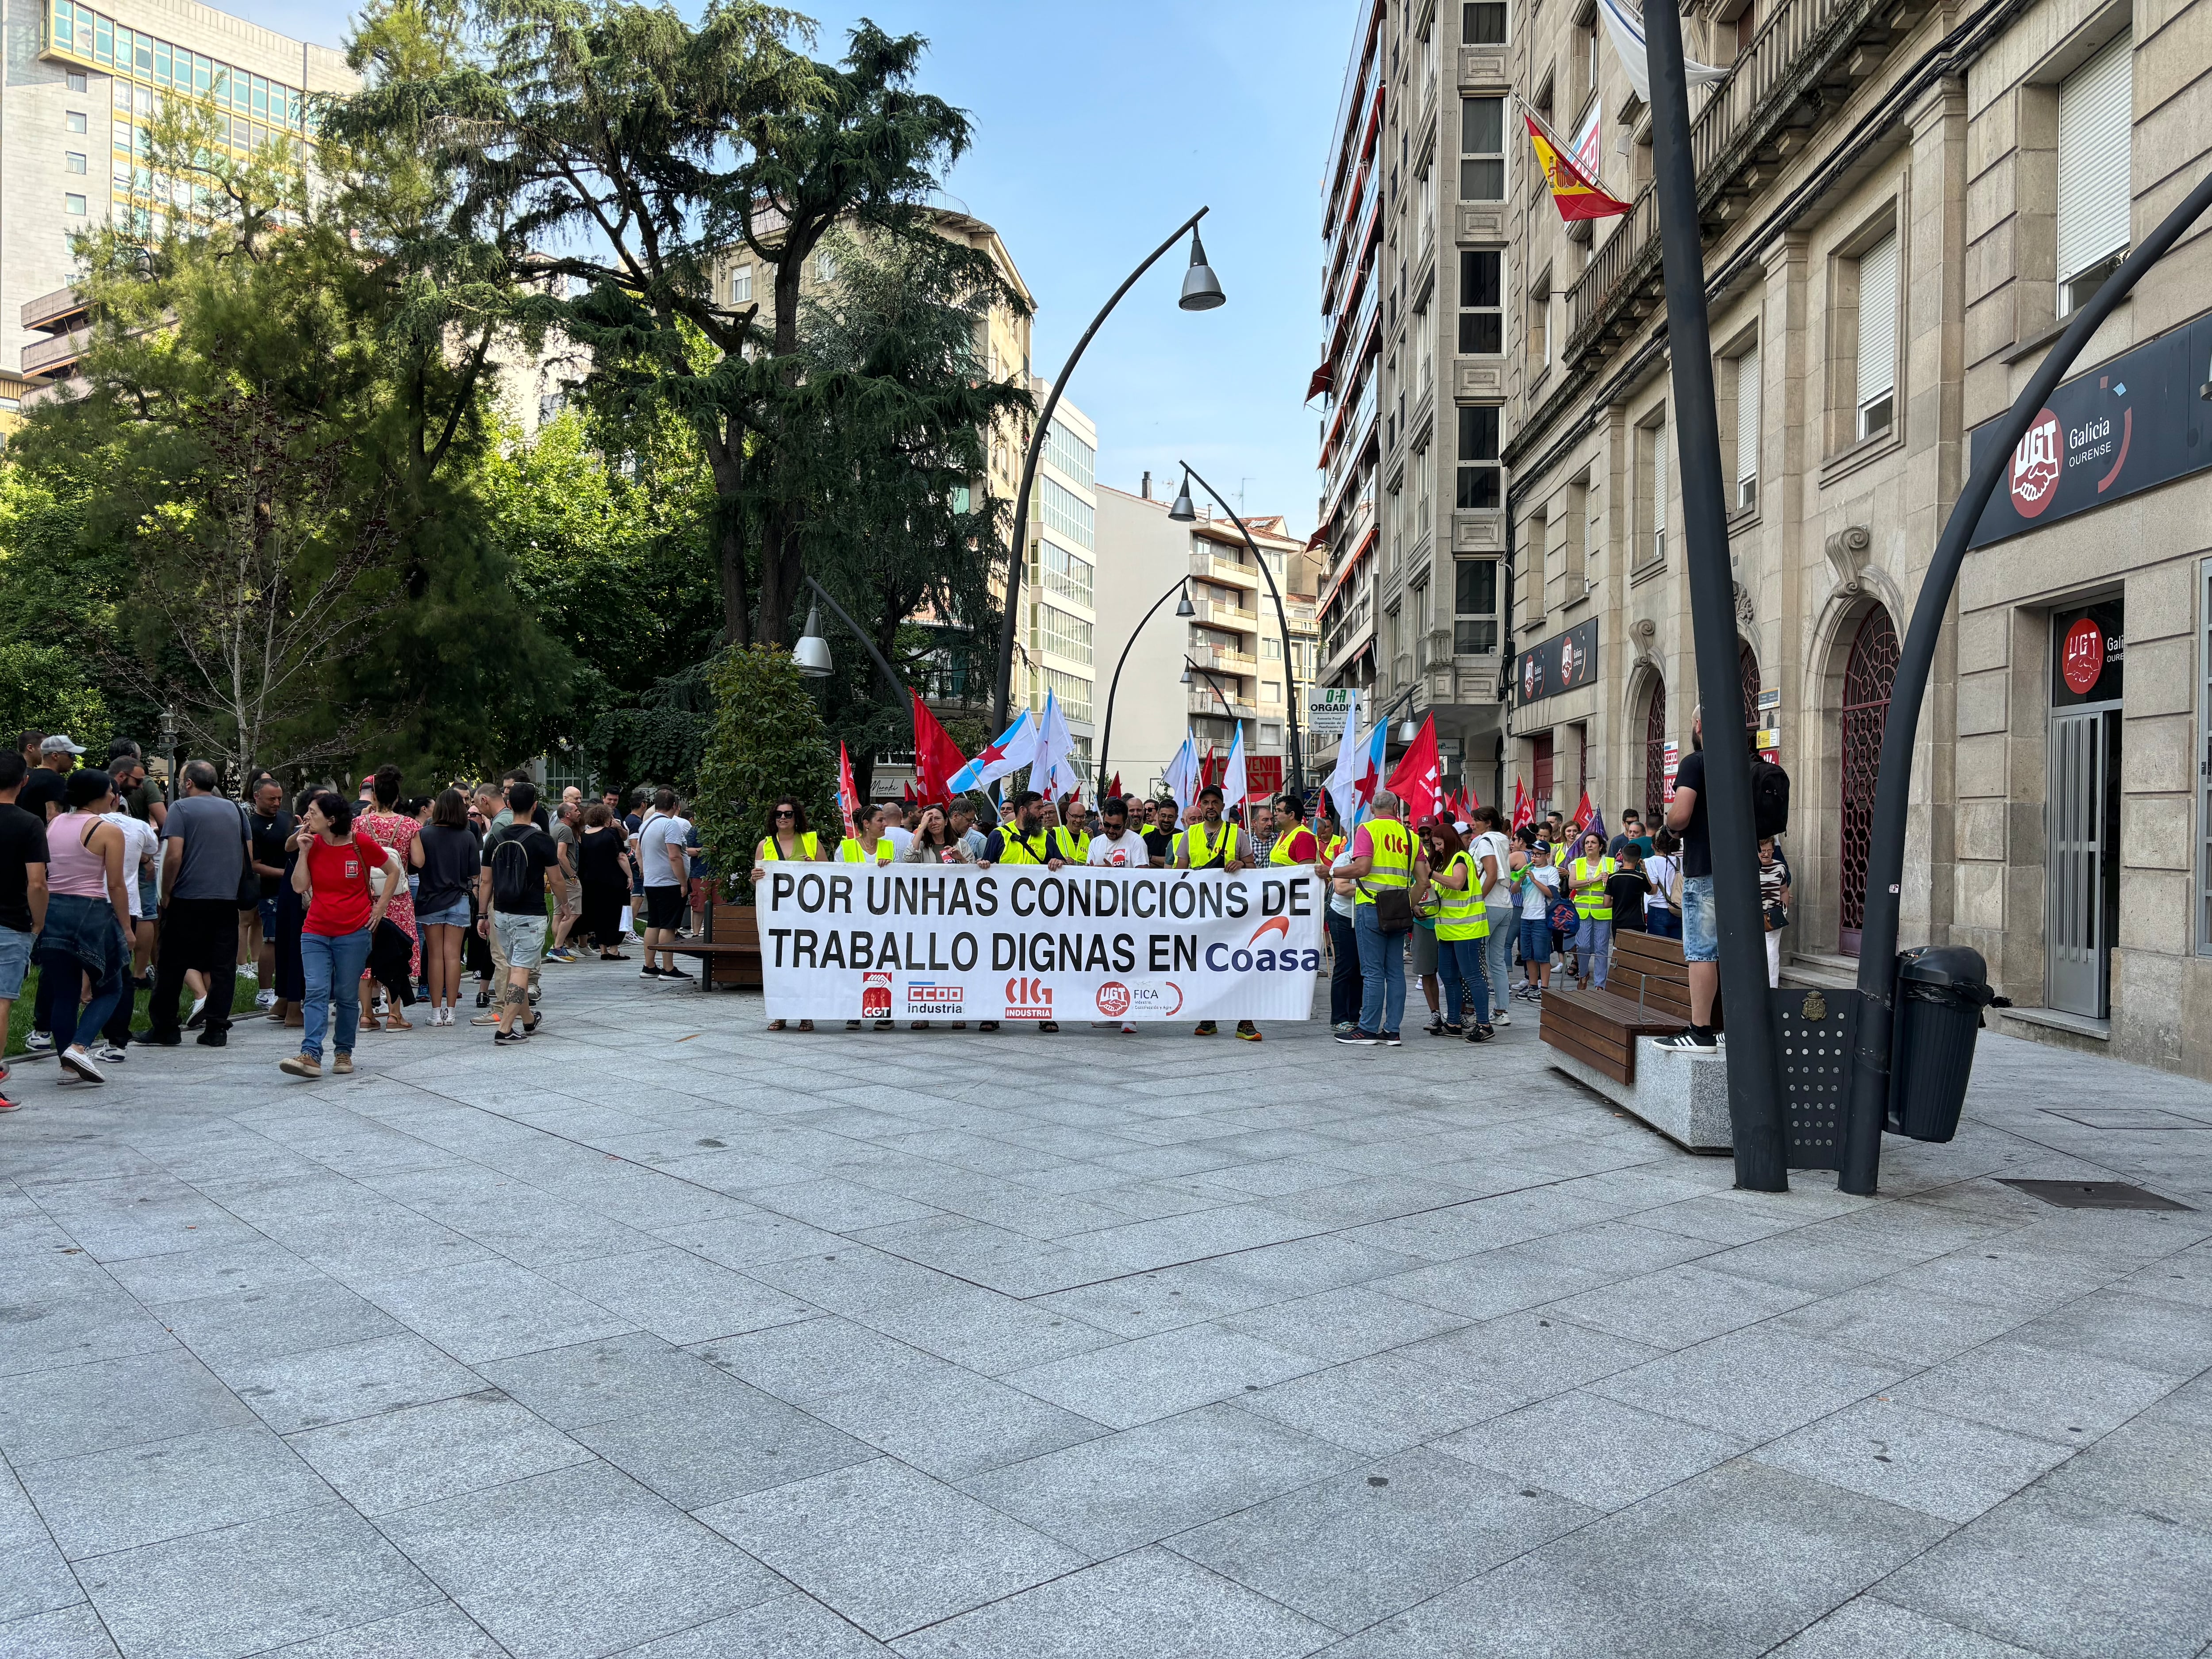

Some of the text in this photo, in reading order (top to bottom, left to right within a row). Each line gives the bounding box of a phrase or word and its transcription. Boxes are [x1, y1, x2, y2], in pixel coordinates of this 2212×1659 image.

[2069, 417, 2110, 449] Galicia
[2014, 419, 2056, 477] UGT
[2069, 441, 2112, 468] OURENSE
[2069, 632, 2097, 661] UGT
[772, 872, 1311, 919] POR UNHAS CONDICIÓNS DE
[769, 929, 1320, 973] TRABALLO DIGNAS EN Coasa
[909, 987, 961, 1000] CCOO
[1006, 977, 1052, 1004] CIG
[1100, 987, 1125, 1002] UGT
[1134, 989, 1159, 999] FICA
[864, 1007, 890, 1017] CGT
[908, 1003, 962, 1014] industria
